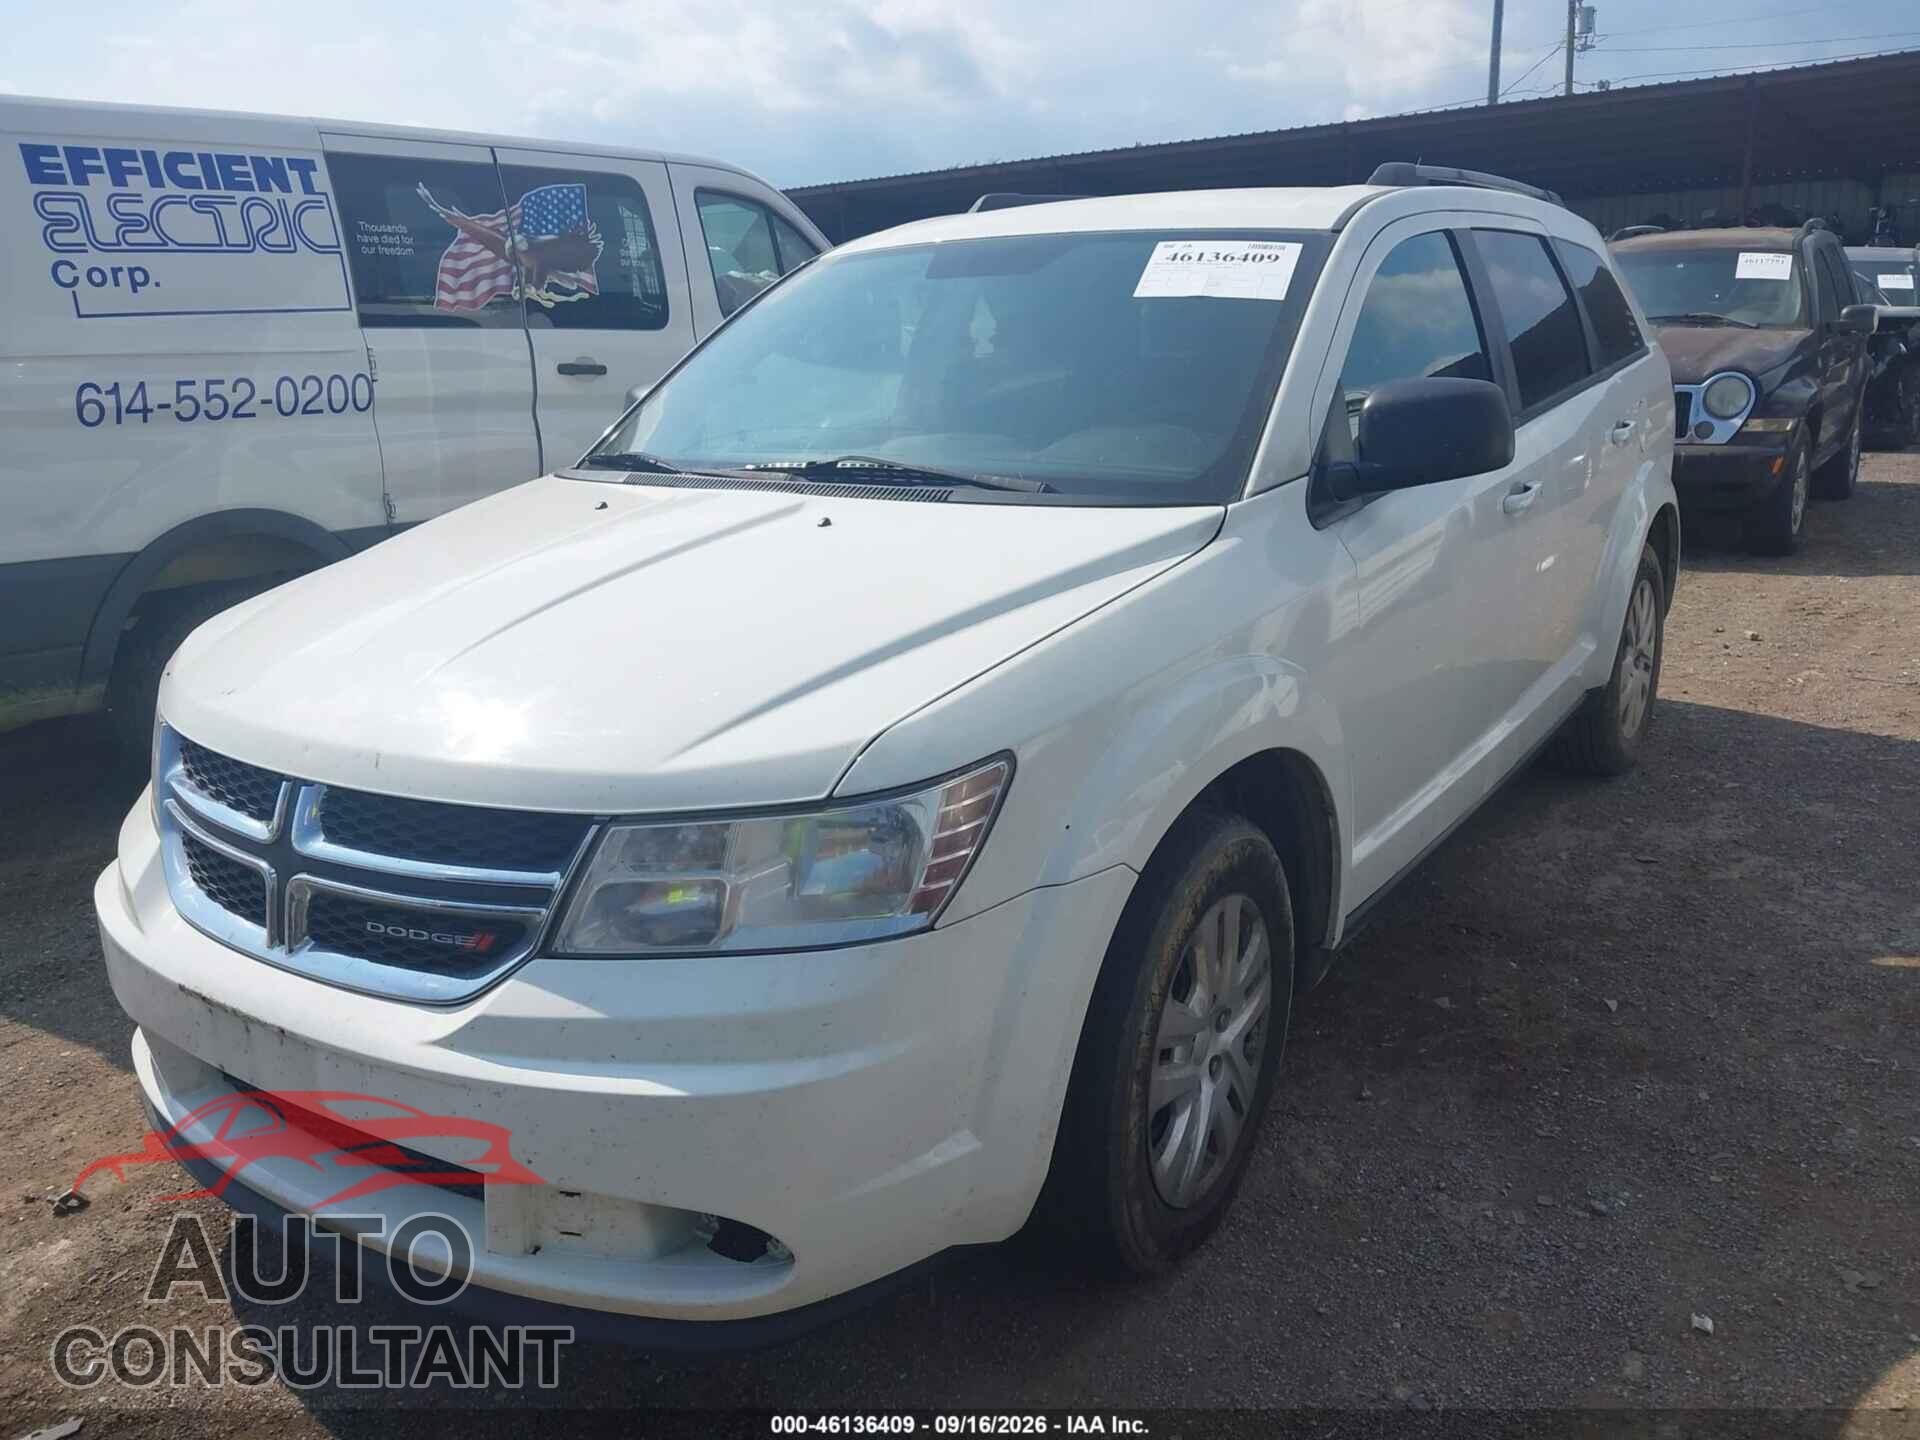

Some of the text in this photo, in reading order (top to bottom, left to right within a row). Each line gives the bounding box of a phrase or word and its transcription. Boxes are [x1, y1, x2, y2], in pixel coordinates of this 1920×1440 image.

[19, 143, 318, 195] EFFICIENT
[33, 191, 342, 254] ELECTRIC
[357, 220, 408, 233] Thousands
[1165, 251, 1280, 264] 46136409
[51, 260, 161, 293] Corp.
[75, 373, 374, 427] 614-552-0200
[366, 921, 478, 947] DODGE
